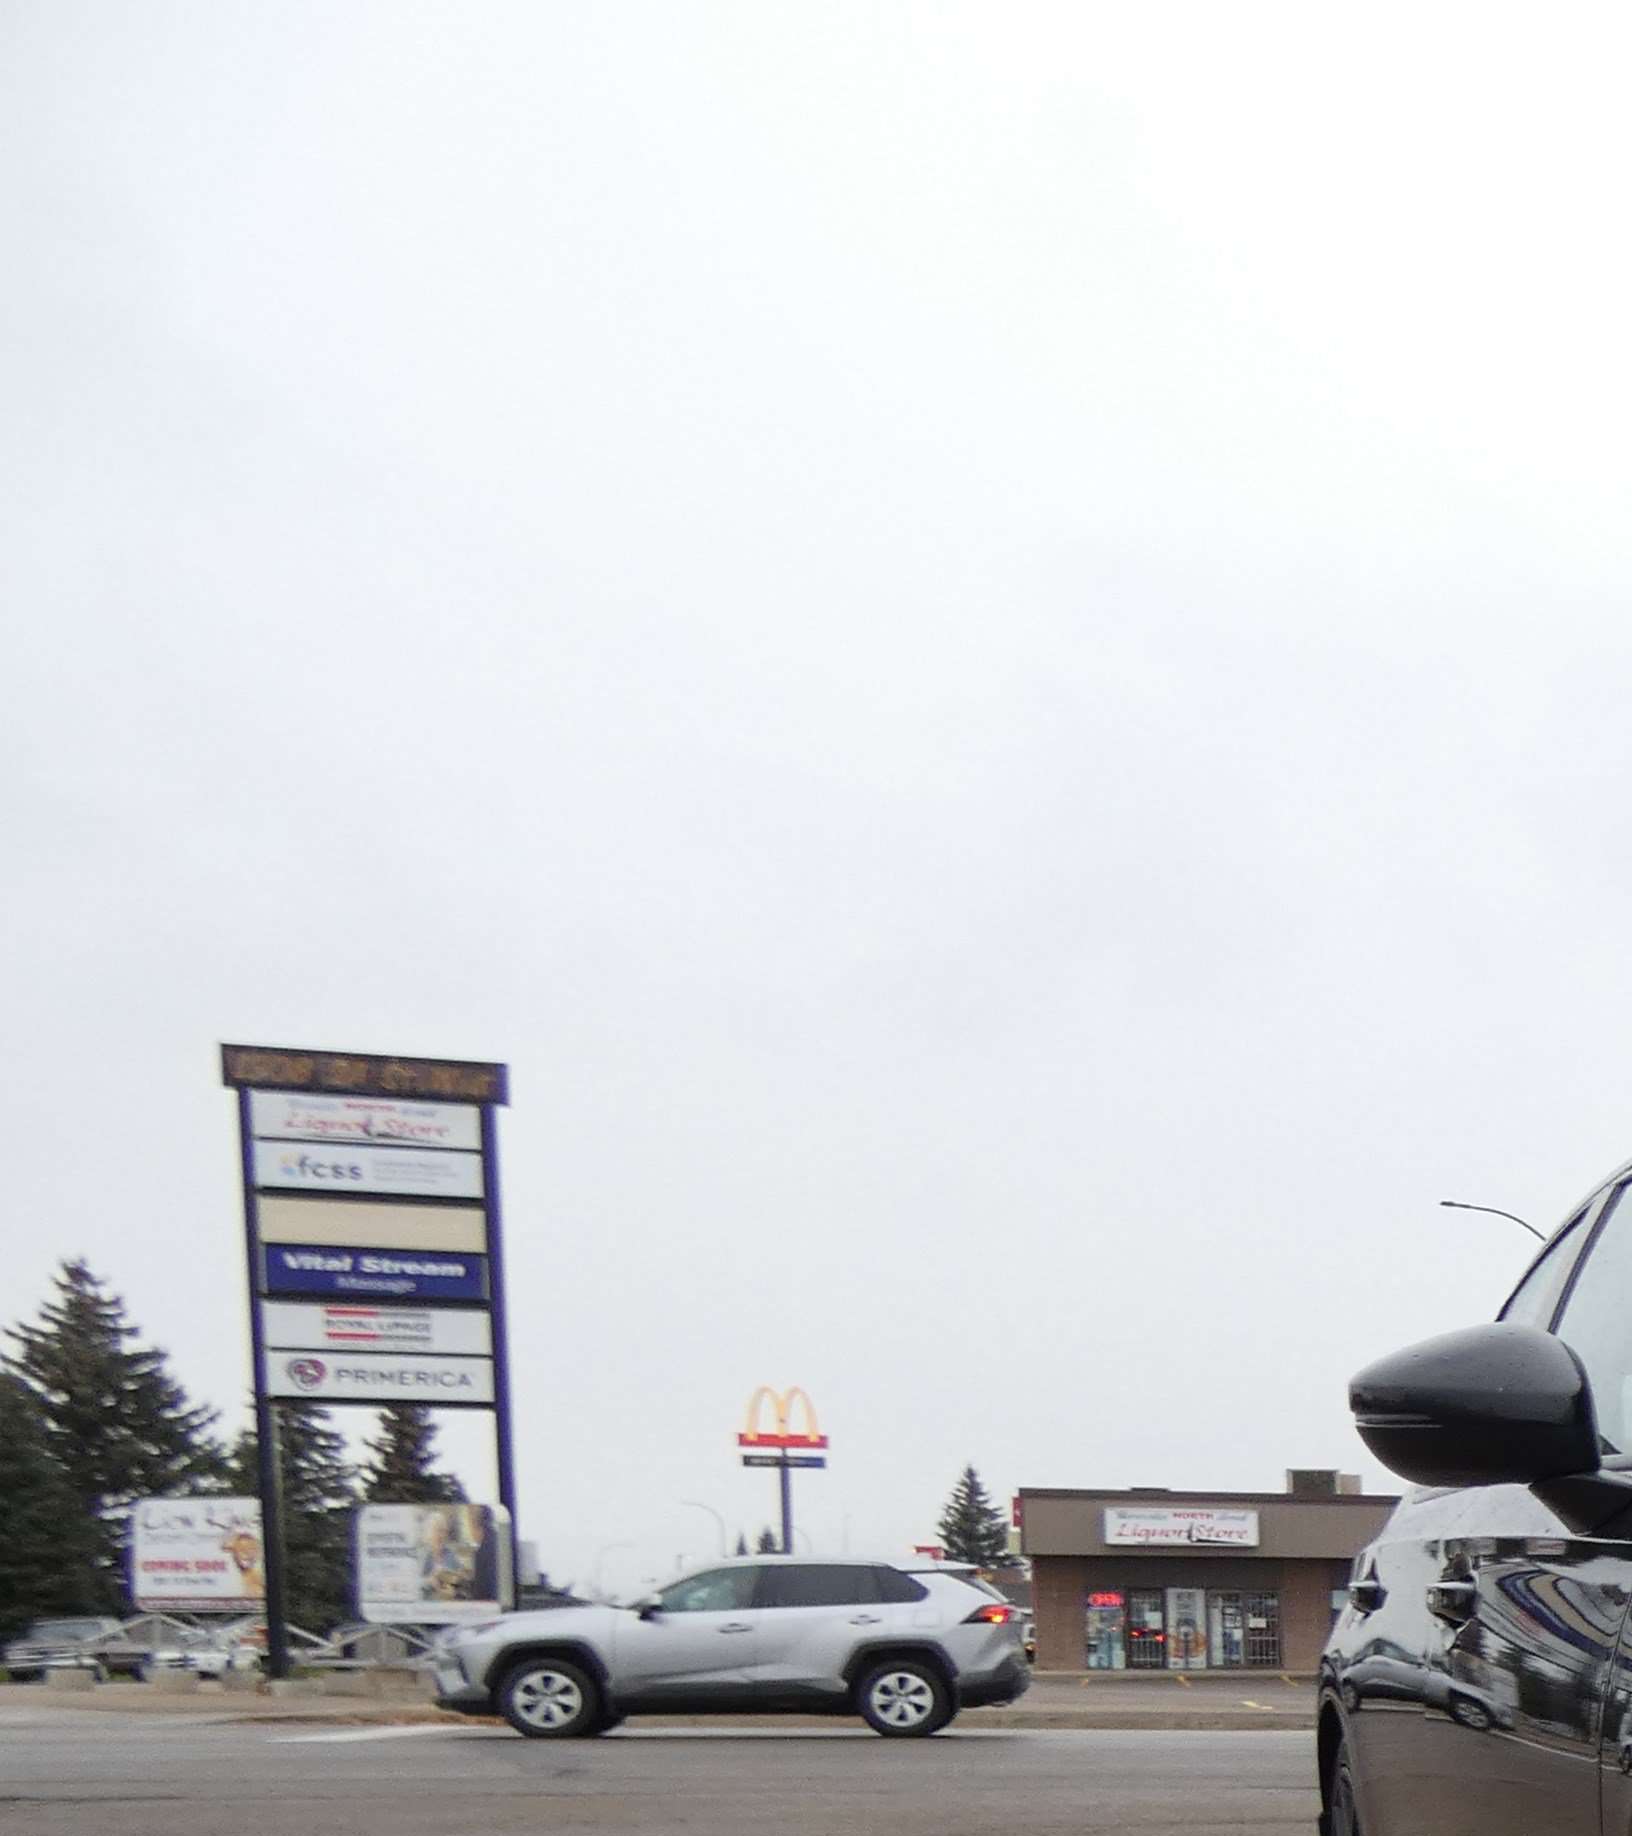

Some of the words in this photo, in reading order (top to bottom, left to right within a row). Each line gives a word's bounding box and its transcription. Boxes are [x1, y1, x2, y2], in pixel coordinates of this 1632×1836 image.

[282, 1251, 353, 1272] Vital
[361, 1257, 466, 1278] Stream
[335, 1367, 473, 1388] PRIMERICA
[1195, 1524, 1249, 1539] Store
